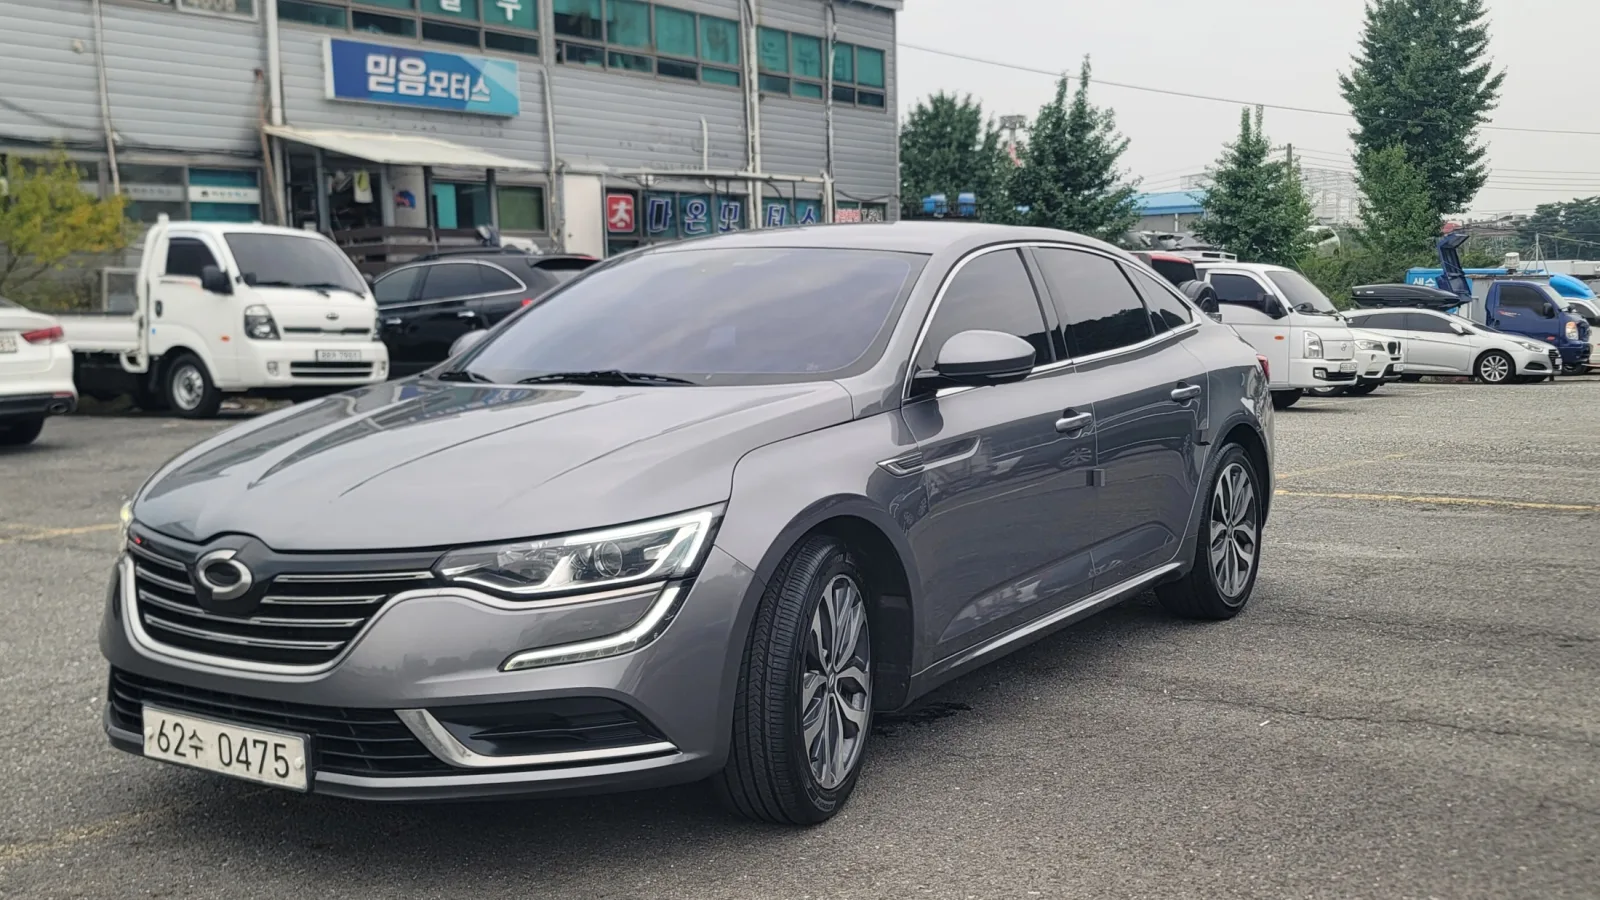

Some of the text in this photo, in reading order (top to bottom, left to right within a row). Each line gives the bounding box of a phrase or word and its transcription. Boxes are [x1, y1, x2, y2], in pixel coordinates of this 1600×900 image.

[366, 54, 491, 102] 믿음모터스
[157, 719, 290, 779] 62수 0475
